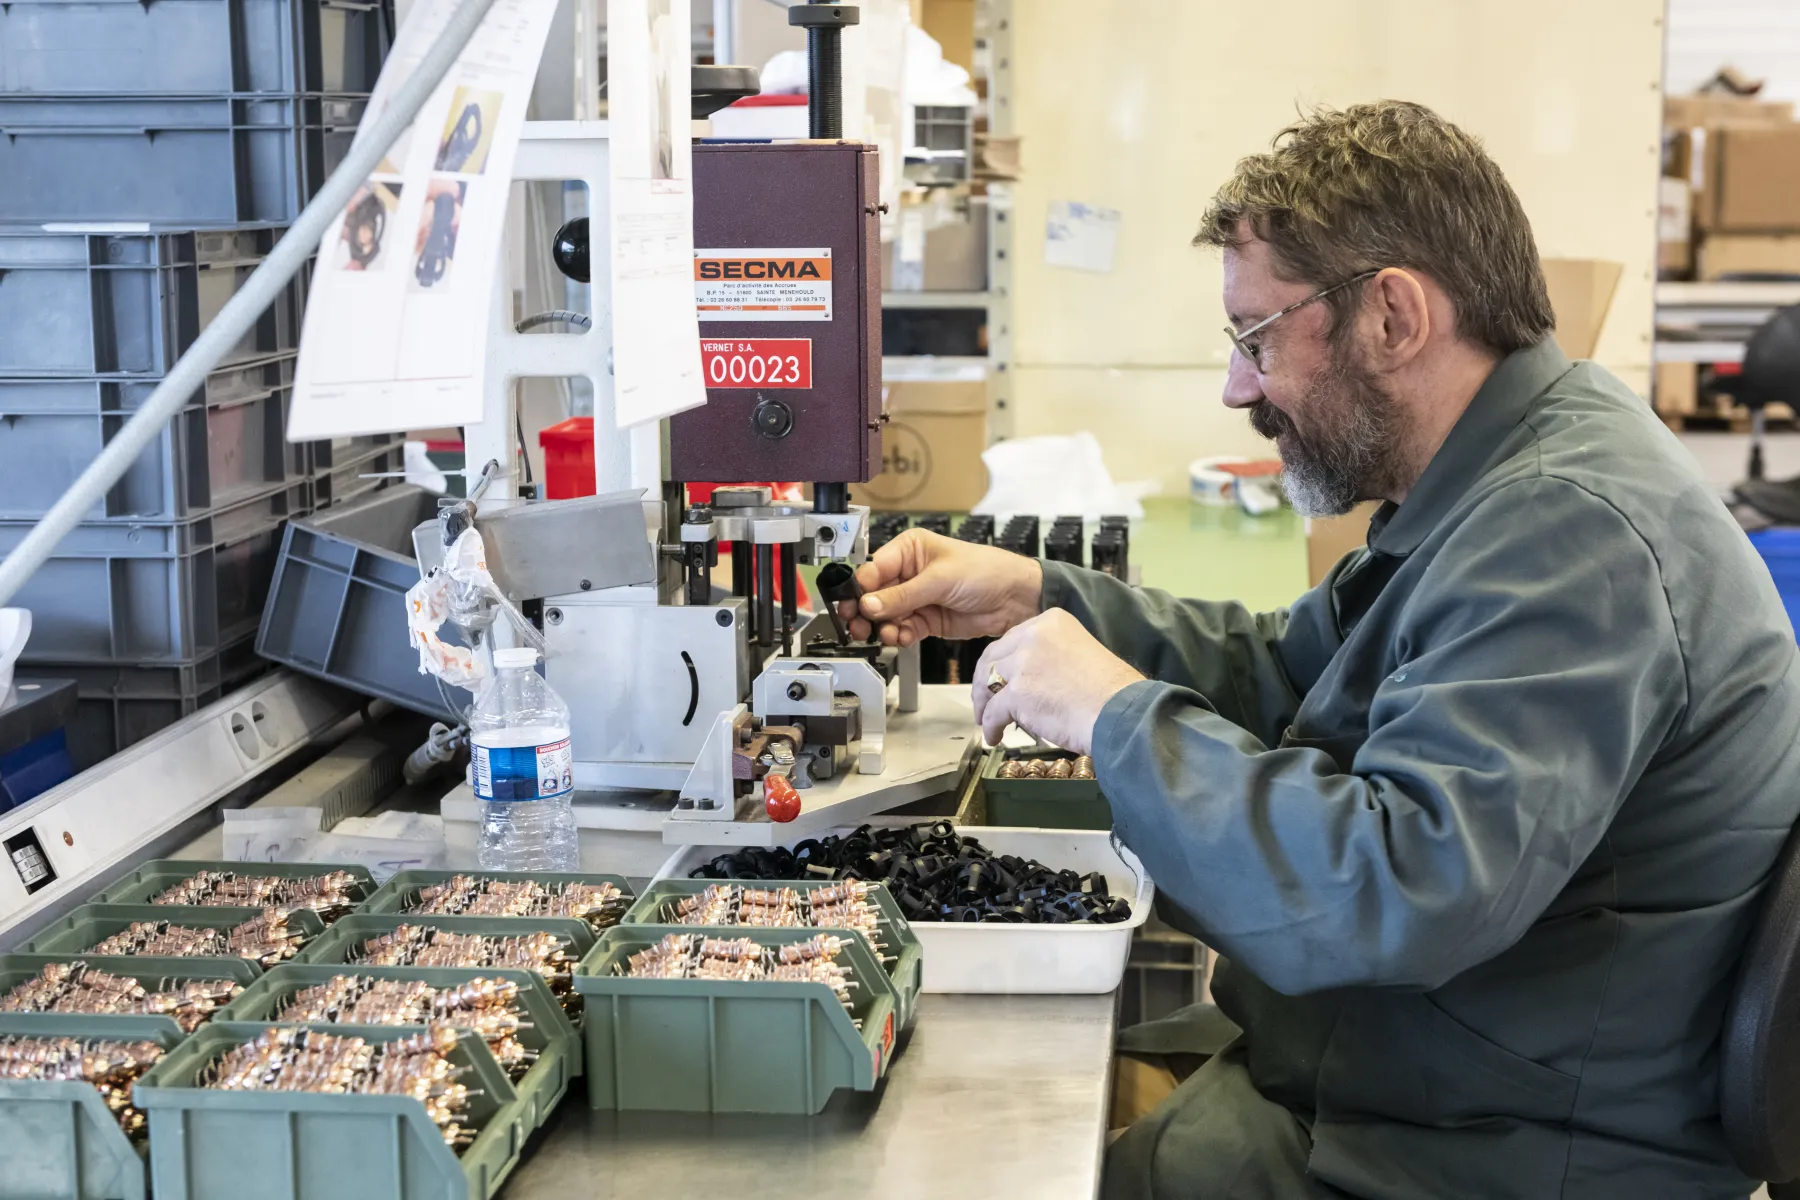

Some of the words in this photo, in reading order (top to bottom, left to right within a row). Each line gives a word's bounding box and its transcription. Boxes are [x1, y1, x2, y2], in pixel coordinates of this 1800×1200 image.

[700, 261, 820, 279] SECMA
[703, 343, 734, 352] VERNET
[738, 343, 755, 352] S.A.
[710, 355, 800, 383] 00023
